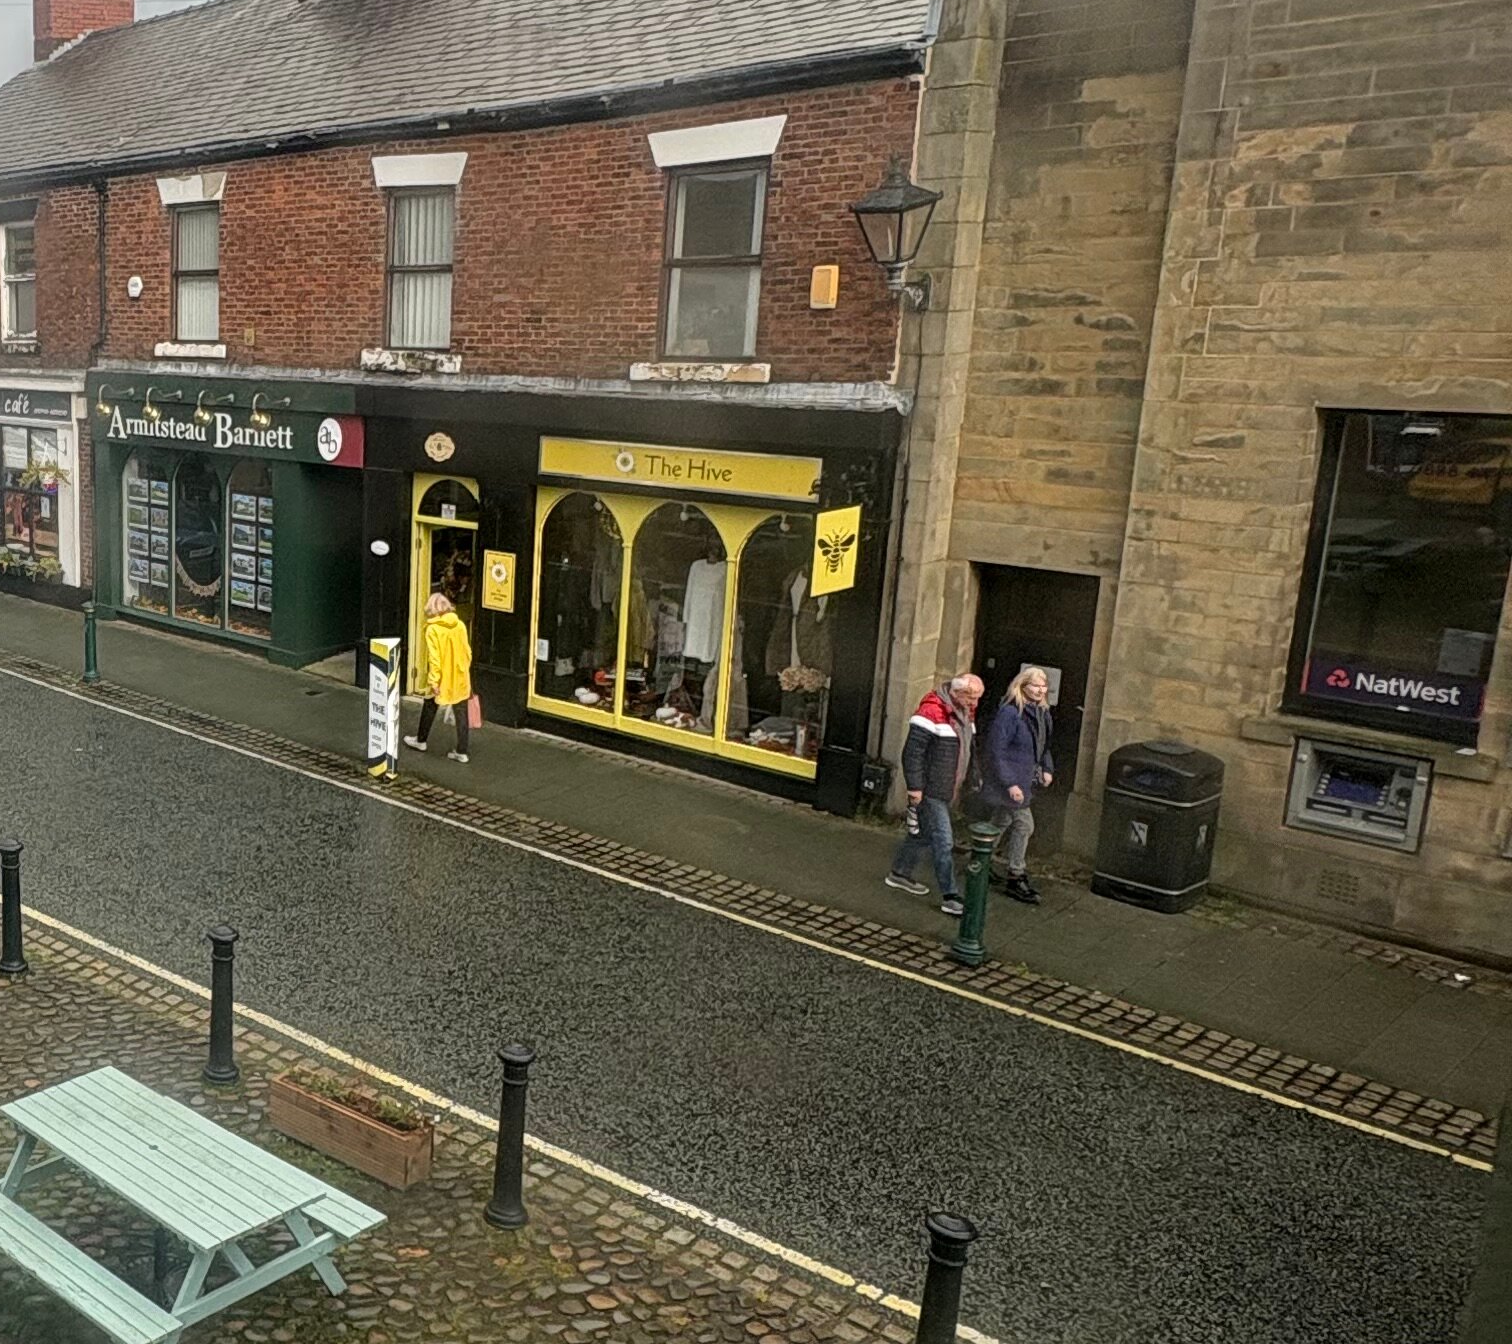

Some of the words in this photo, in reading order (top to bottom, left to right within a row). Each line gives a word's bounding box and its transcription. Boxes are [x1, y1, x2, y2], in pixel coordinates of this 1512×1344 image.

[4, 392, 29, 415] café
[107, 406, 207, 442] Armitstead
[213, 412, 294, 450] Barnett
[644, 455, 682, 478] The
[687, 458, 733, 482] Hive
[1354, 671, 1462, 706] NatWest
[371, 701, 385, 716] THE
